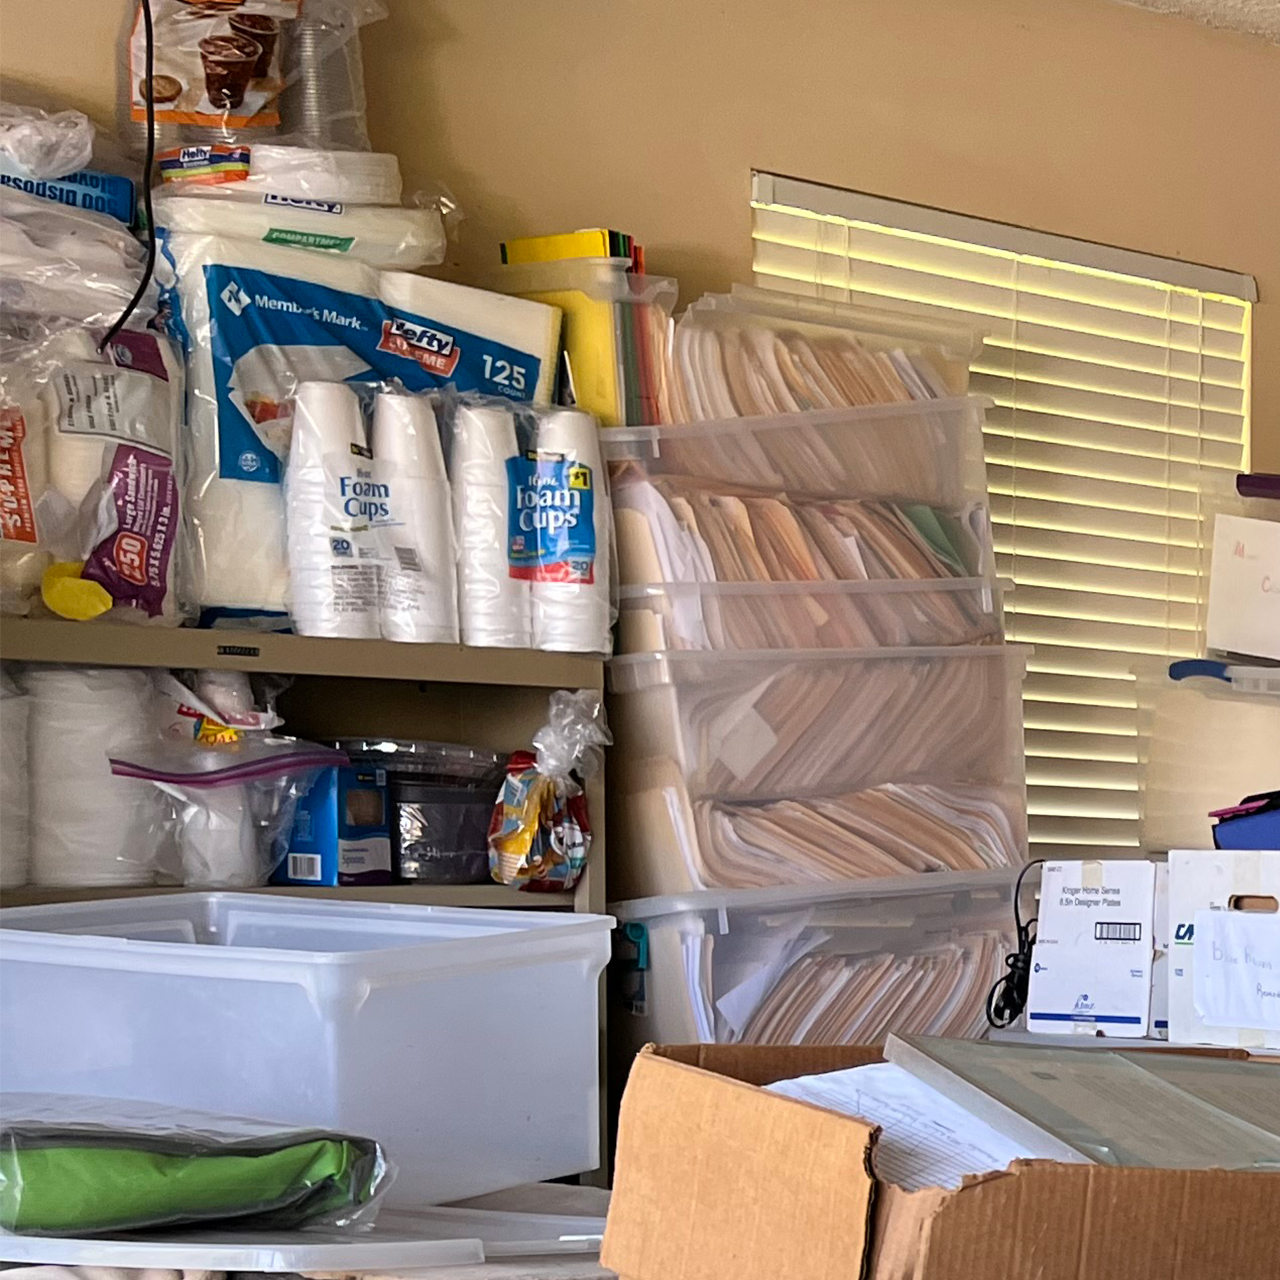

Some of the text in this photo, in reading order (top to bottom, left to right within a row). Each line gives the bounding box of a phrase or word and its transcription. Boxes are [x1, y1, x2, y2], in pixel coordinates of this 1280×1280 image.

[255, 294, 361, 330] Membr's Mark
[482, 353, 526, 390] 125
[339, 477, 390, 498] Foam
[516, 485, 581, 509] Foam
[344, 497, 389, 521] Cups
[519, 508, 578, 535] Cups
[332, 539, 350, 551] 20
[119, 538, 142, 578] 250
[572, 560, 589, 571] 20
[1062, 886, 1120, 897] Kroger Home Sense
[1075, 898, 1101, 908] Designer
[1102, 898, 1121, 907] Plates
